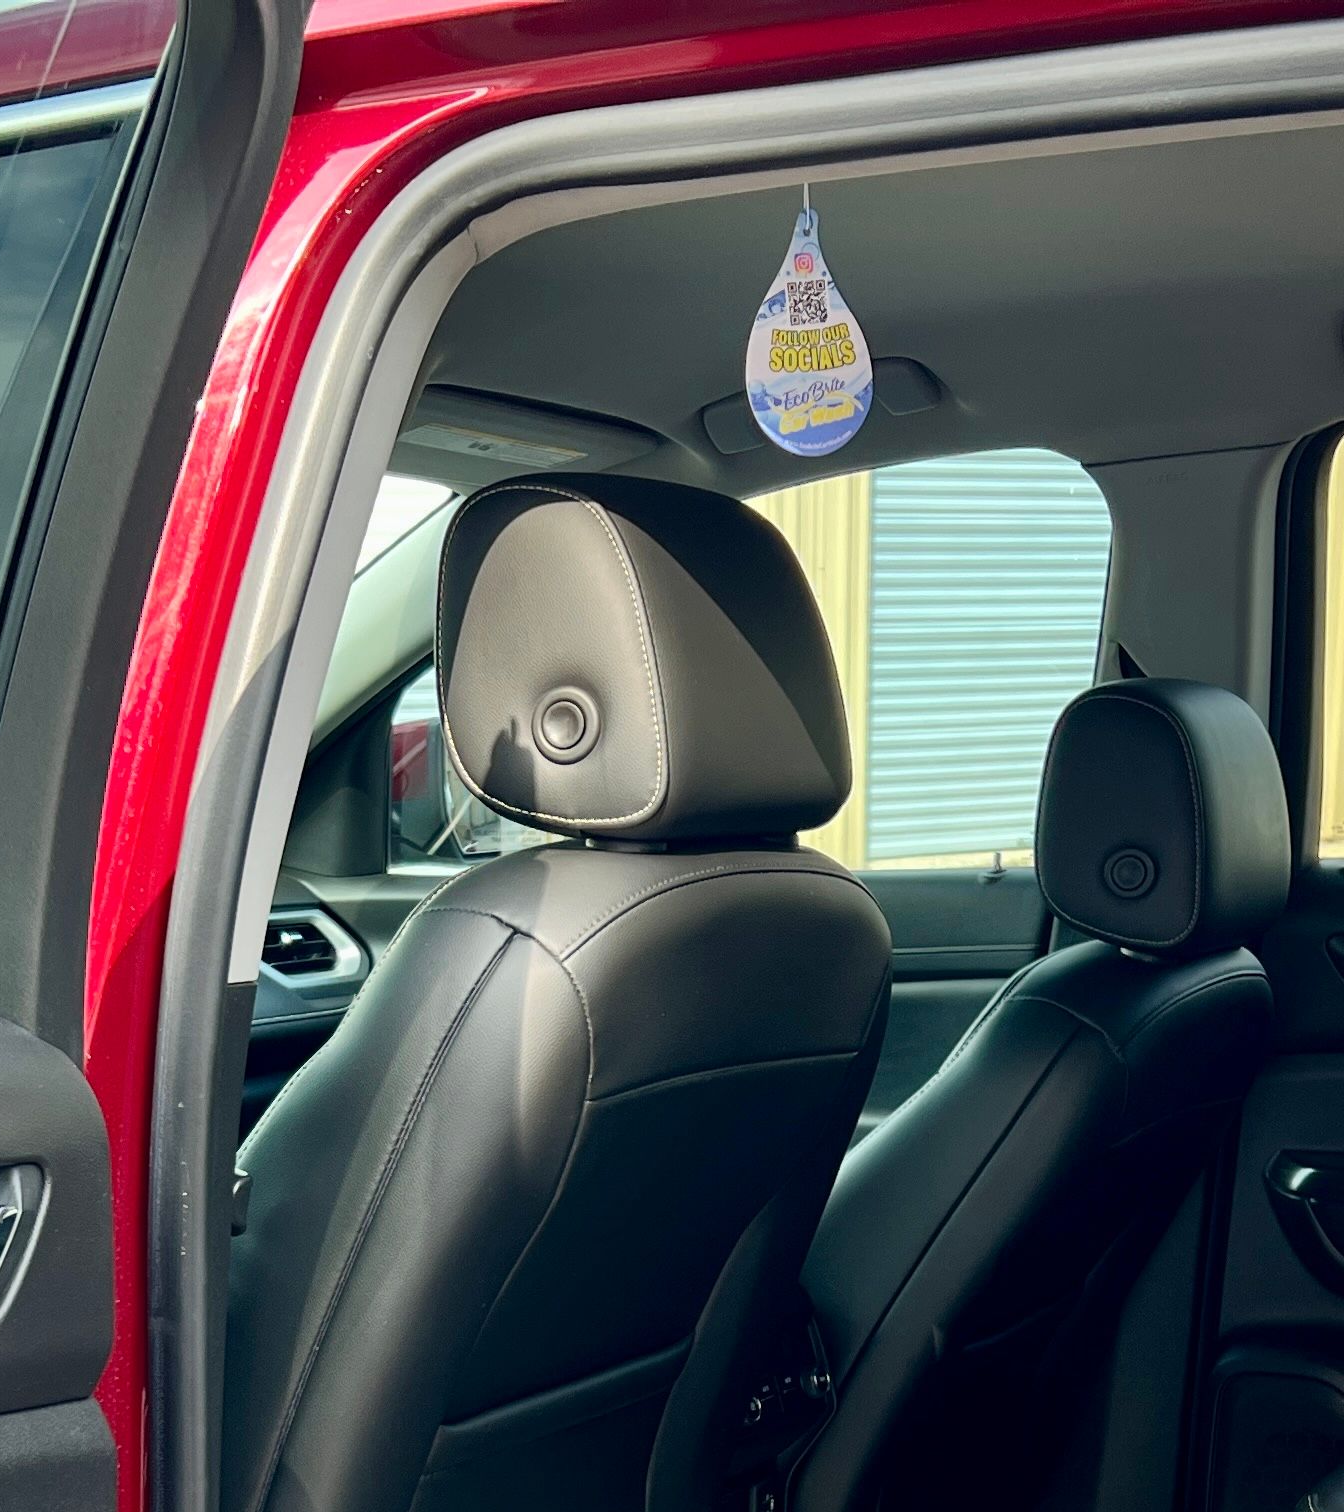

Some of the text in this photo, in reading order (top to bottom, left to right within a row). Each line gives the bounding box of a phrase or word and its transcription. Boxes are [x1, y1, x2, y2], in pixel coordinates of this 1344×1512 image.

[771, 322, 850, 347] FOLLOW OUR
[769, 339, 856, 372] SOCIALS
